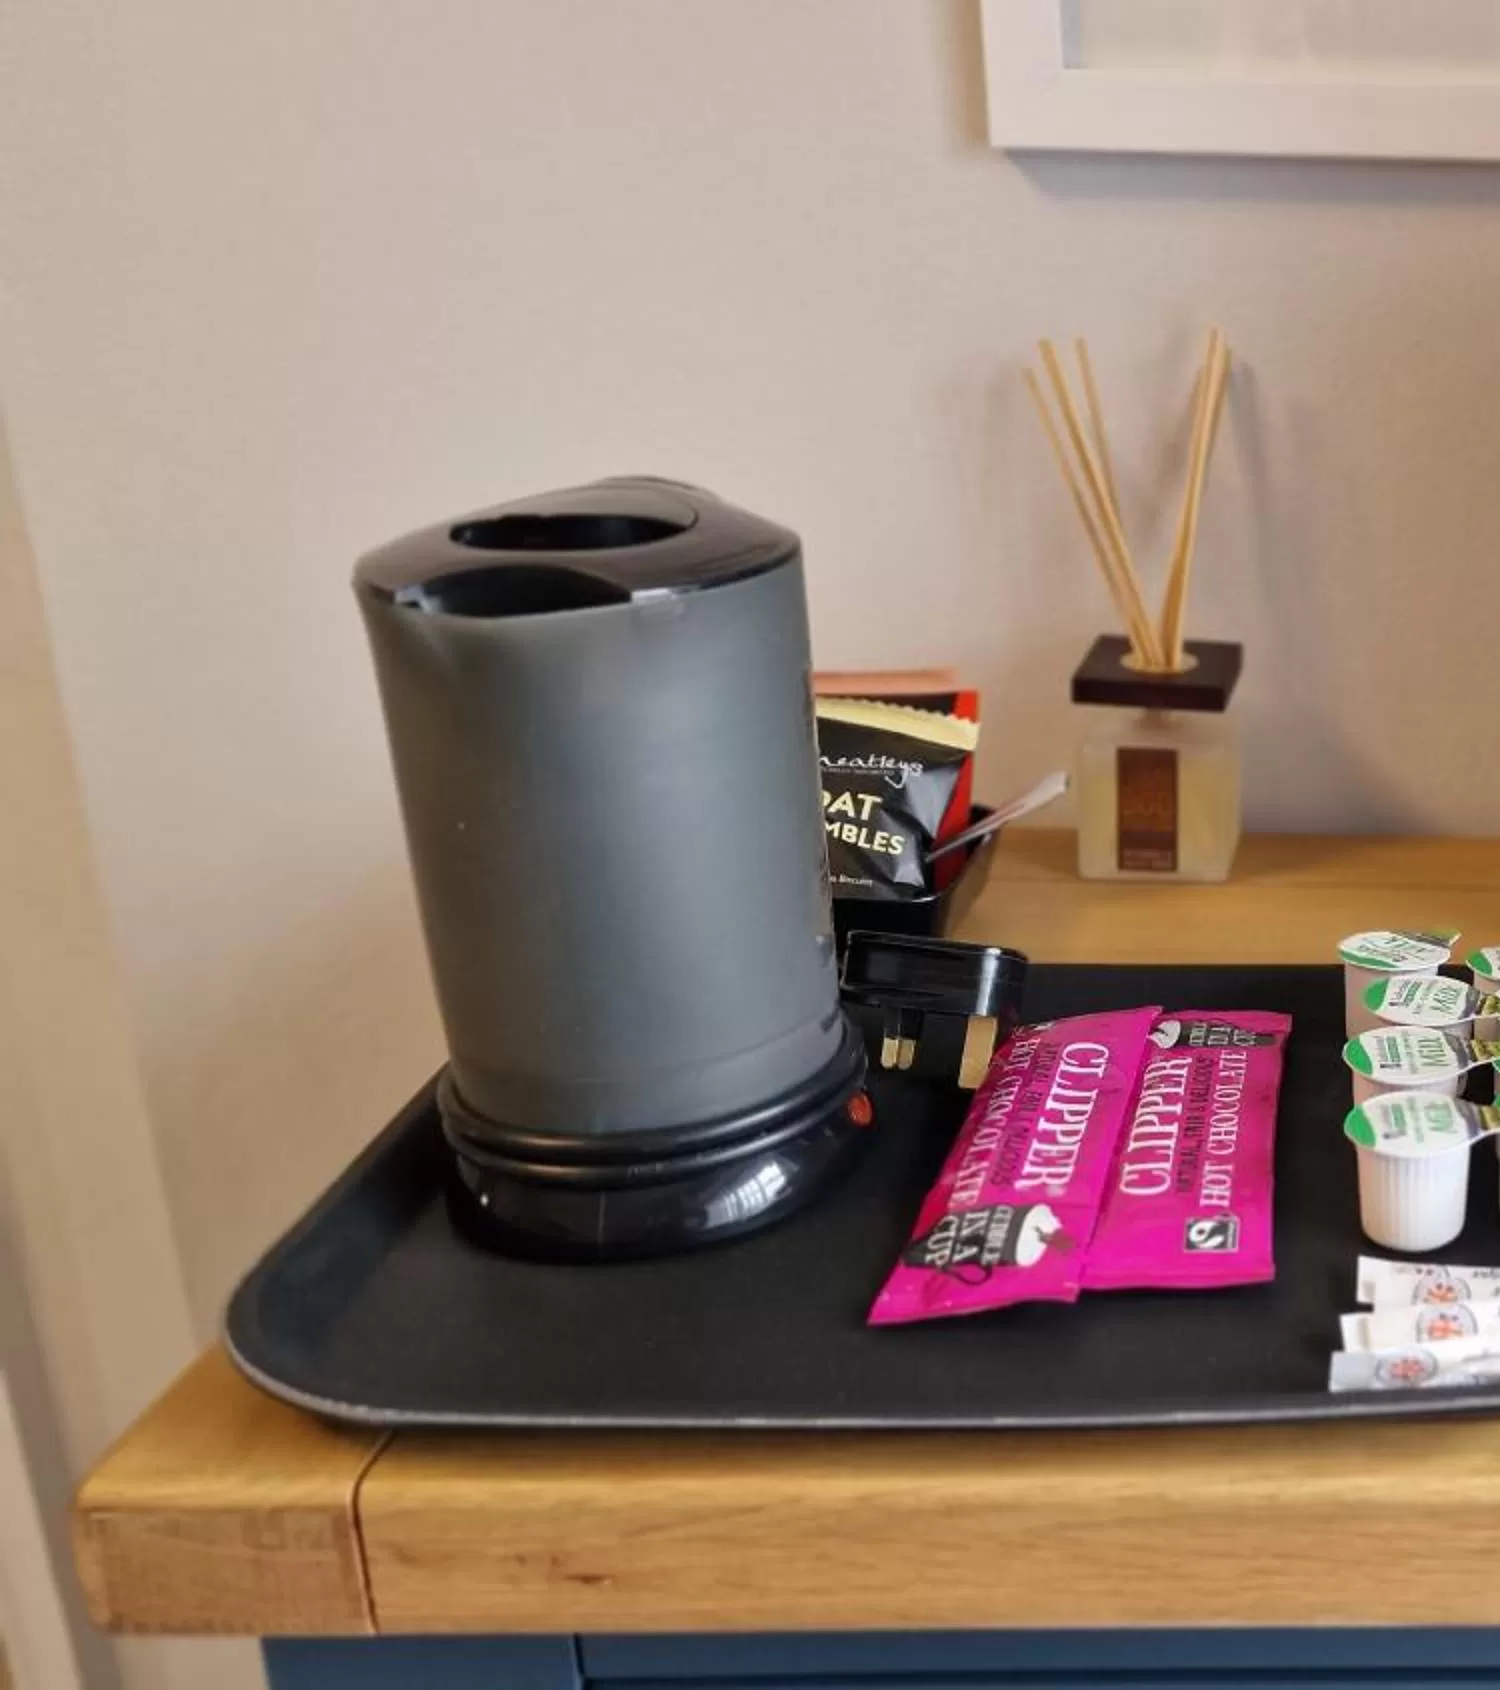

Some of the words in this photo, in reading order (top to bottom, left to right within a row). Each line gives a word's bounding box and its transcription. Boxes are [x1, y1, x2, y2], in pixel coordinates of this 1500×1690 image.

[947, 1075, 1023, 1209] CHOCOLATE
[1013, 1041, 1110, 1190] CLIPPER
[1119, 1056, 1192, 1196] CLIPPER
[1207, 1049, 1248, 1156] CHOCOLATE
[960, 1209, 991, 1237] IN
[1199, 1160, 1234, 1208] HOT
[924, 1215, 959, 1267] CUP
[952, 1243, 980, 1263] A
